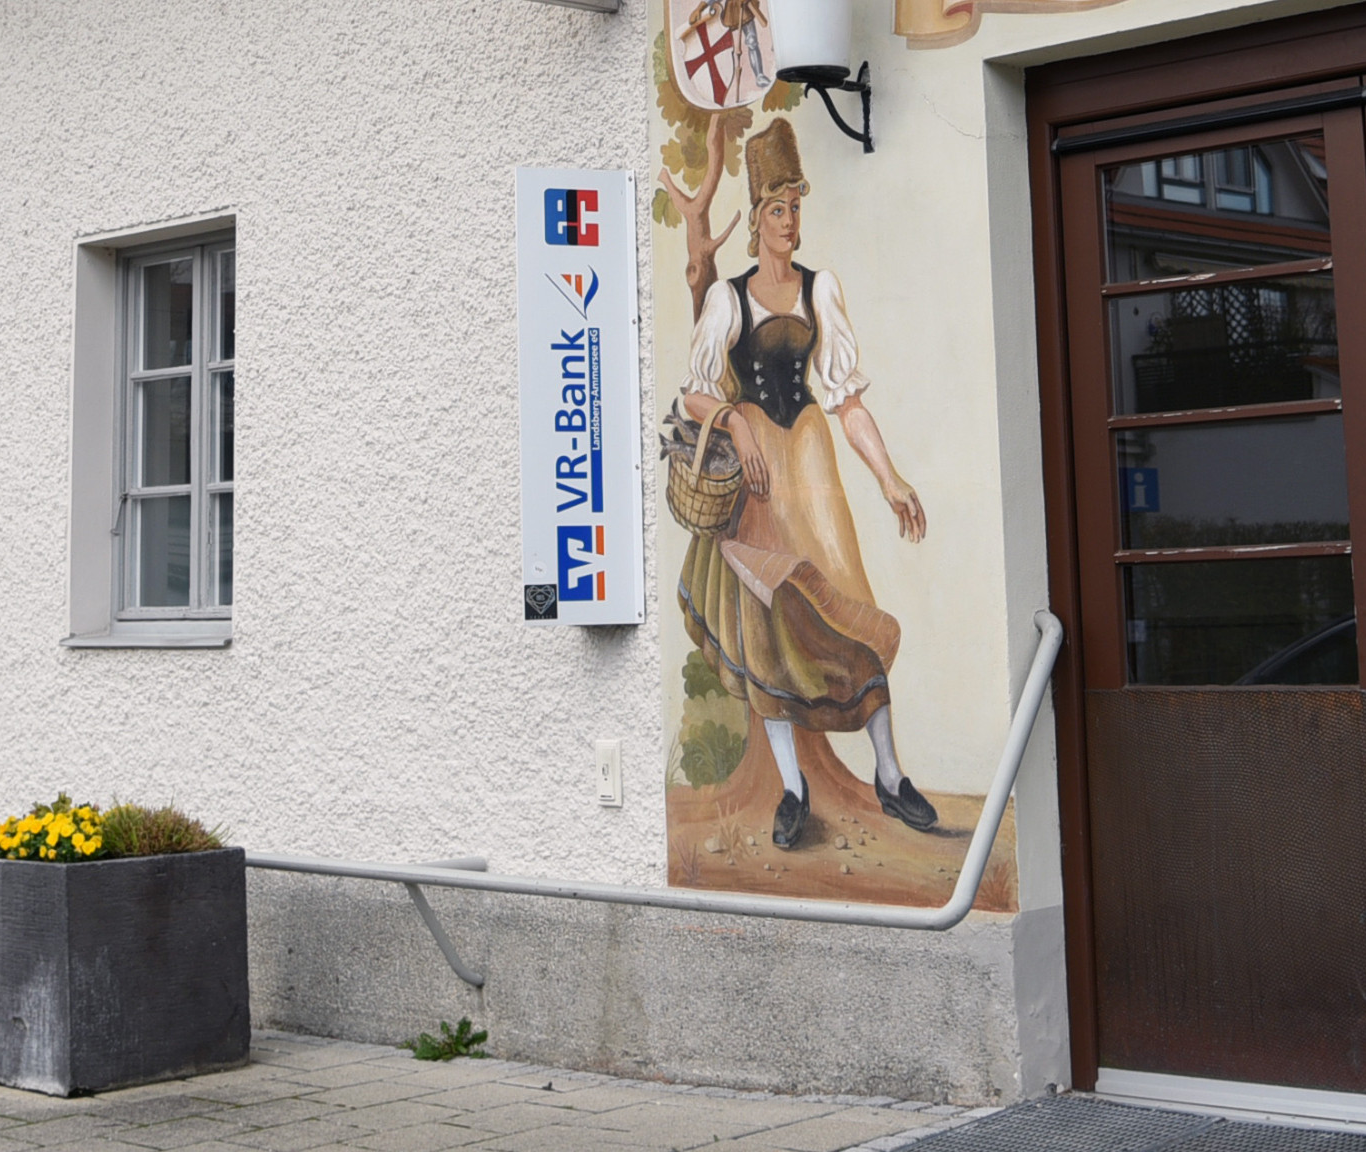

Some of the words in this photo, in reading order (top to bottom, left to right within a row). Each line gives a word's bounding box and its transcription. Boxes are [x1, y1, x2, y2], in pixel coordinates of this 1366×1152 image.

[589, 329, 599, 343] eG
[550, 328, 588, 513] VR-Bank
[589, 345, 602, 451] Landsberg-Ammersee
